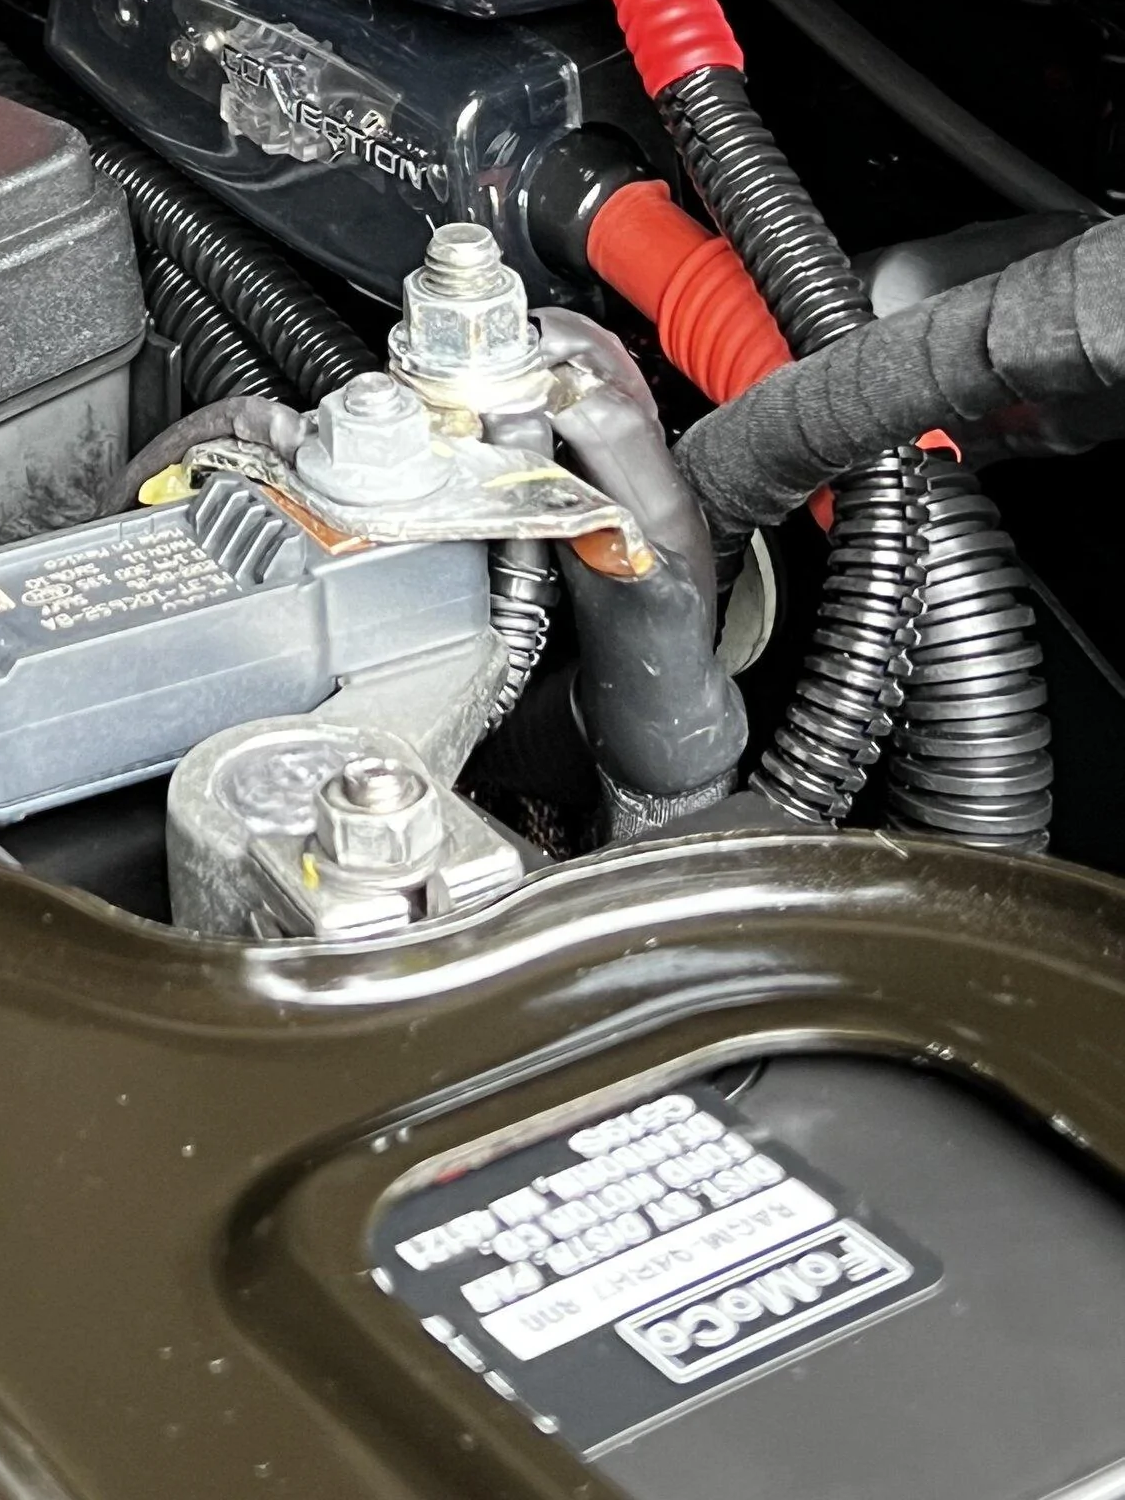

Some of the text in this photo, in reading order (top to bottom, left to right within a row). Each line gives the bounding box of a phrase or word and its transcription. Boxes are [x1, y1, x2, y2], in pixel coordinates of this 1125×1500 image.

[656, 1131, 755, 1189] FORD
[689, 1153, 786, 1206] DIST.
[541, 1172, 665, 1239] MOTOR
[646, 1191, 703, 1231] BY
[643, 1236, 883, 1355] FoMoCo
